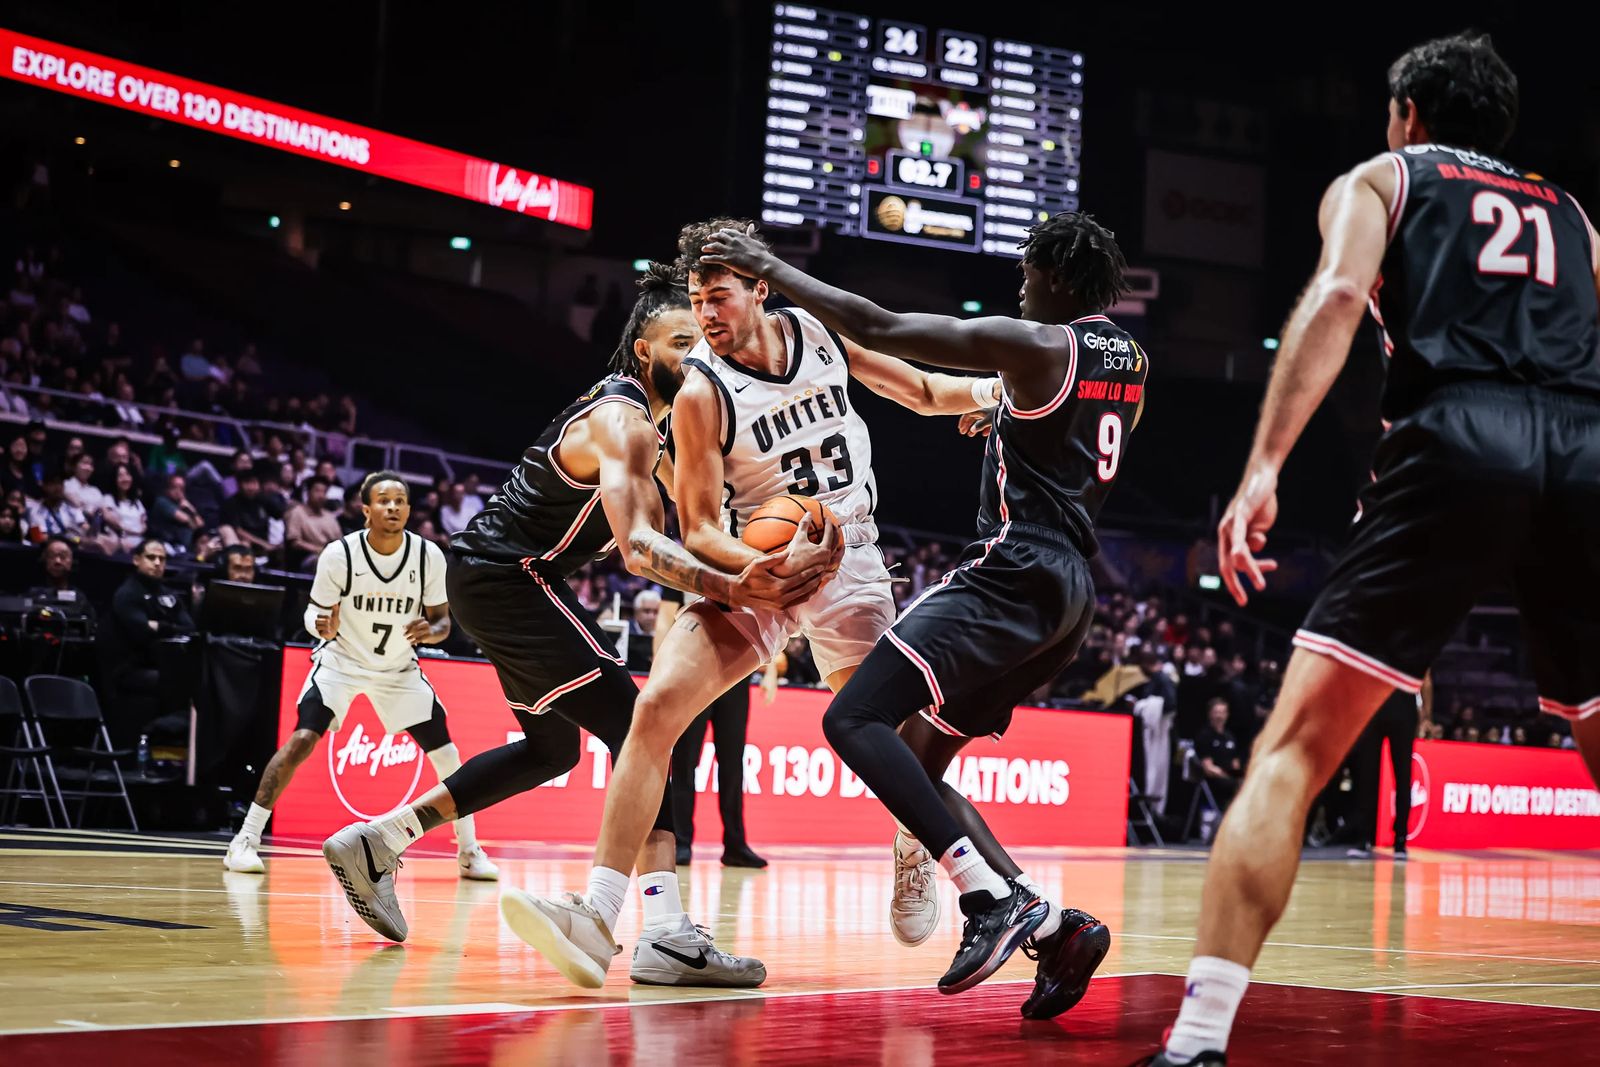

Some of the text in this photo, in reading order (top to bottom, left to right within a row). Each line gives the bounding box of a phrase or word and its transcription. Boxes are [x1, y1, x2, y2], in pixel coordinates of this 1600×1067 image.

[884, 26, 919, 56] 24
[944, 37, 978, 66] 22
[12, 45, 370, 165] EXPLORE OVER 130 DESTINATIONS
[1471, 190, 1556, 287] 21
[1083, 332, 1131, 353] Greater
[1103, 351, 1134, 371] Bank
[1107, 382, 1122, 401] LO
[752, 385, 847, 453] UNITED
[780, 432, 853, 496] 33
[1097, 411, 1122, 482] 9
[353, 594, 415, 614] UNITED
[372, 622, 393, 656] 7
[336, 723, 418, 777] AirAsia
[769, 745, 835, 798] 130
